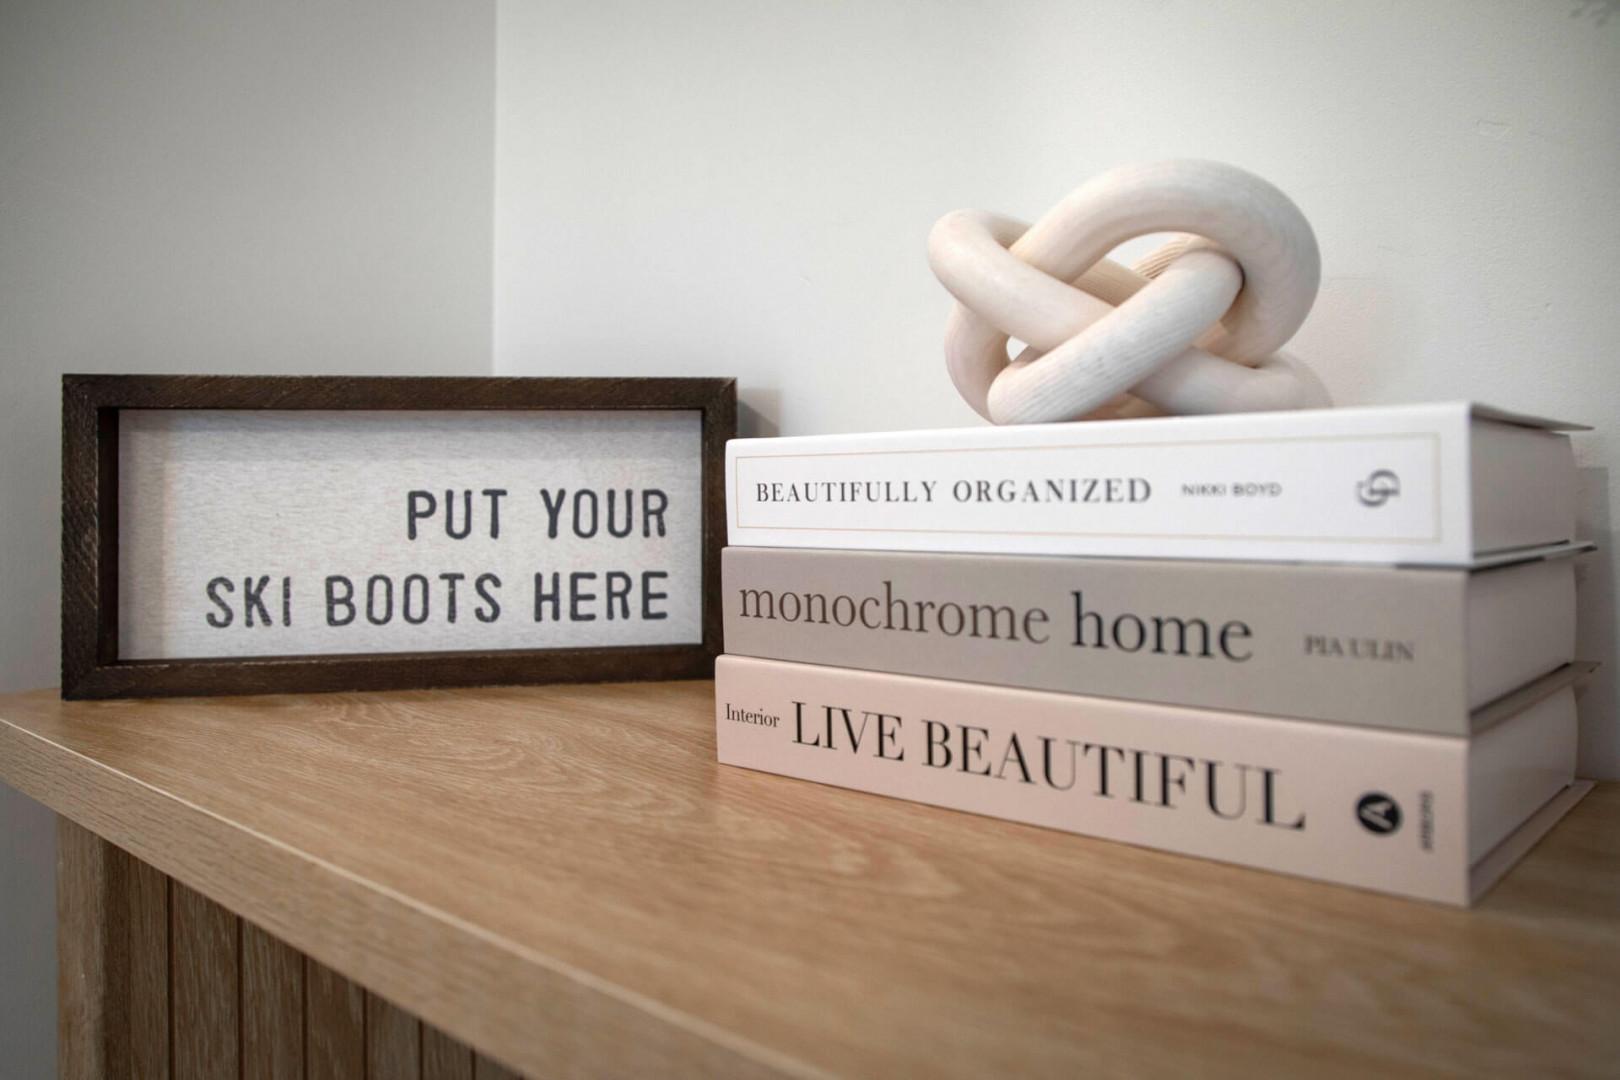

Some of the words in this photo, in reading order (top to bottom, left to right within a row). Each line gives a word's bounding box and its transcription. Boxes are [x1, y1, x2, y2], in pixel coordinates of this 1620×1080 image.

[407, 488, 507, 540] PUT
[540, 488, 669, 540] YOUR
[755, 480, 937, 503] BEAUTIFULLY
[952, 477, 1152, 504] ORGANIZED
[1181, 482, 1227, 497] NIKKI
[1231, 481, 1283, 498] BOYD
[205, 575, 292, 628] SKI
[324, 572, 502, 627] BOOTS
[533, 570, 669, 622] HERE
[738, 580, 1050, 645] monochrome
[1069, 590, 1254, 663] home
[724, 702, 781, 728] Interior
[790, 701, 905, 762] LIVE
[920, 719, 1306, 831] BEAUTIFUL
